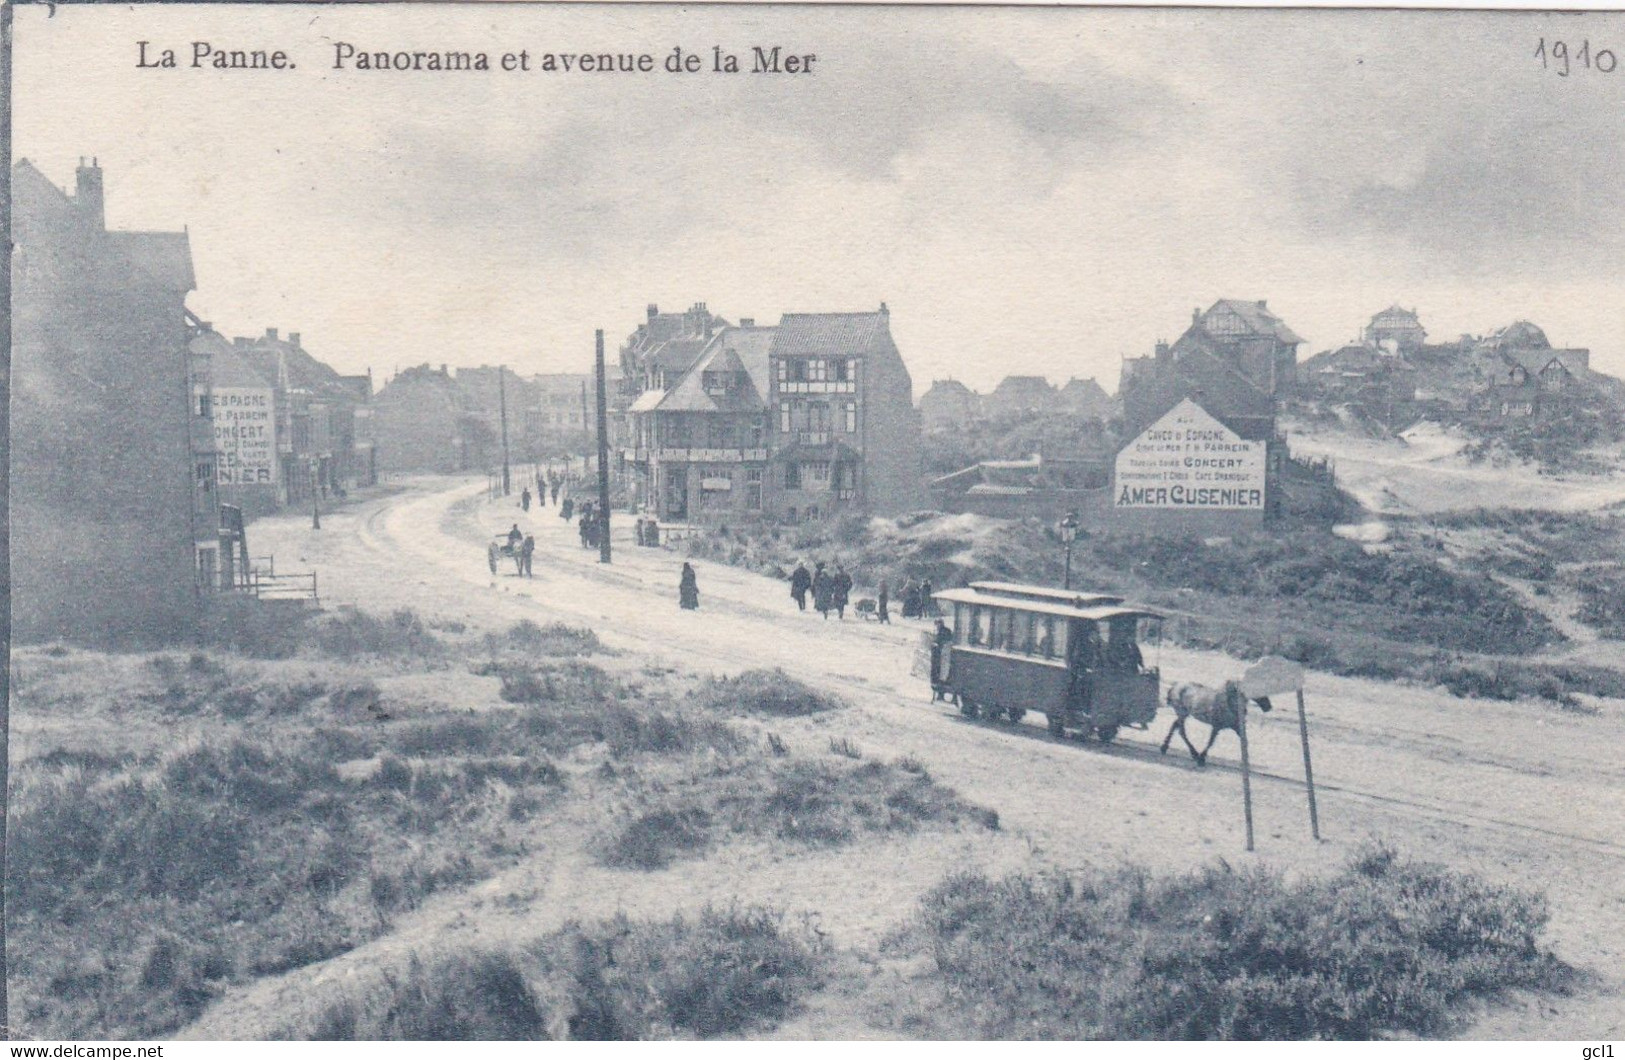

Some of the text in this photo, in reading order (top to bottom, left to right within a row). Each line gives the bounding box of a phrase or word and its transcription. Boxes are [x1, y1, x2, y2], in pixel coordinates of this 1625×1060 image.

[1534, 37, 1617, 77] 1910
[215, 426, 264, 439] ONCERT
[1184, 457, 1244, 468] CONCERT
[1118, 485, 1261, 505] AMER CUSENIER
